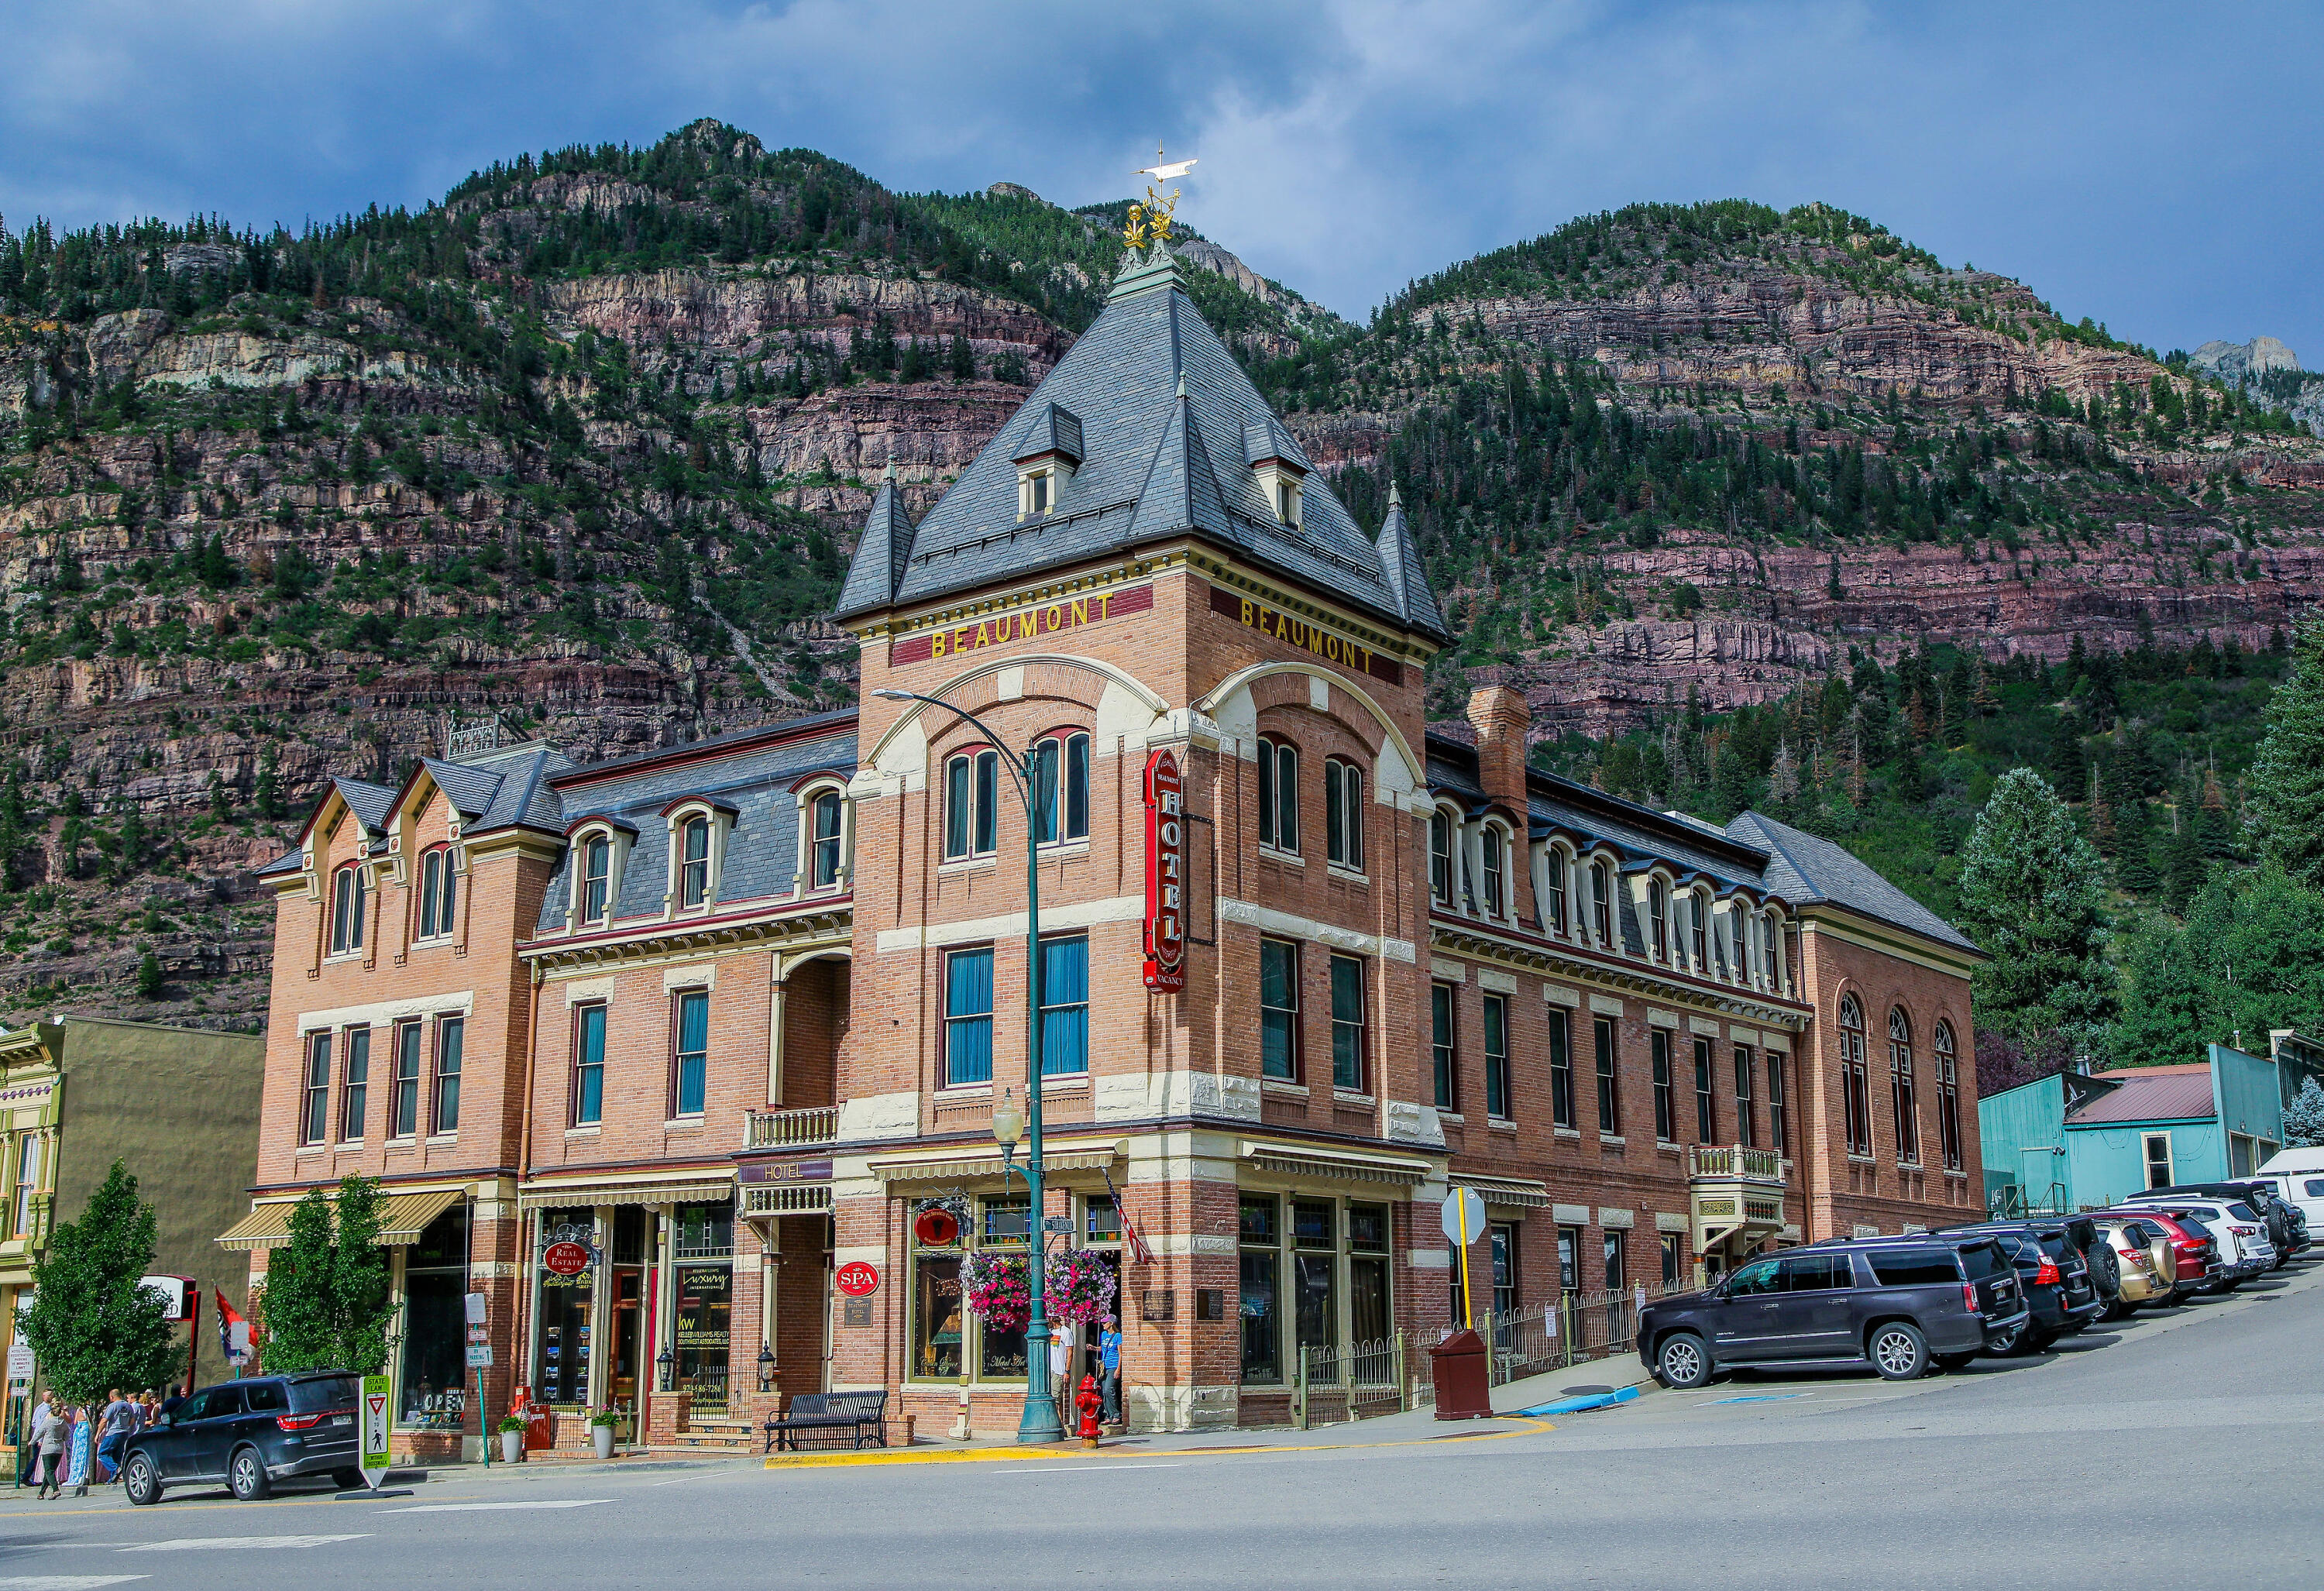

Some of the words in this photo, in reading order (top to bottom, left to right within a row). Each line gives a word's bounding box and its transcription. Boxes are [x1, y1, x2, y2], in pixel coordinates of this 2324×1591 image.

[932, 592, 1114, 658] BEAUMONT
[1241, 598, 1373, 674] BEAUMONT
[1157, 773, 1179, 785] BEAUMONT
[1160, 789, 1181, 941] HOTEL
[1157, 974, 1184, 986] VACANCY
[765, 1163, 803, 1180] HOTEL
[556, 1248, 578, 1257] REAL
[552, 1257, 582, 1266] ESTATE
[682, 1270, 729, 1290] Luxury
[841, 1272, 875, 1285] SPA
[990, 1355, 1011, 1367] Metal
[1011, 1356, 1026, 1367] Art
[424, 1393, 465, 1411] OPEN
